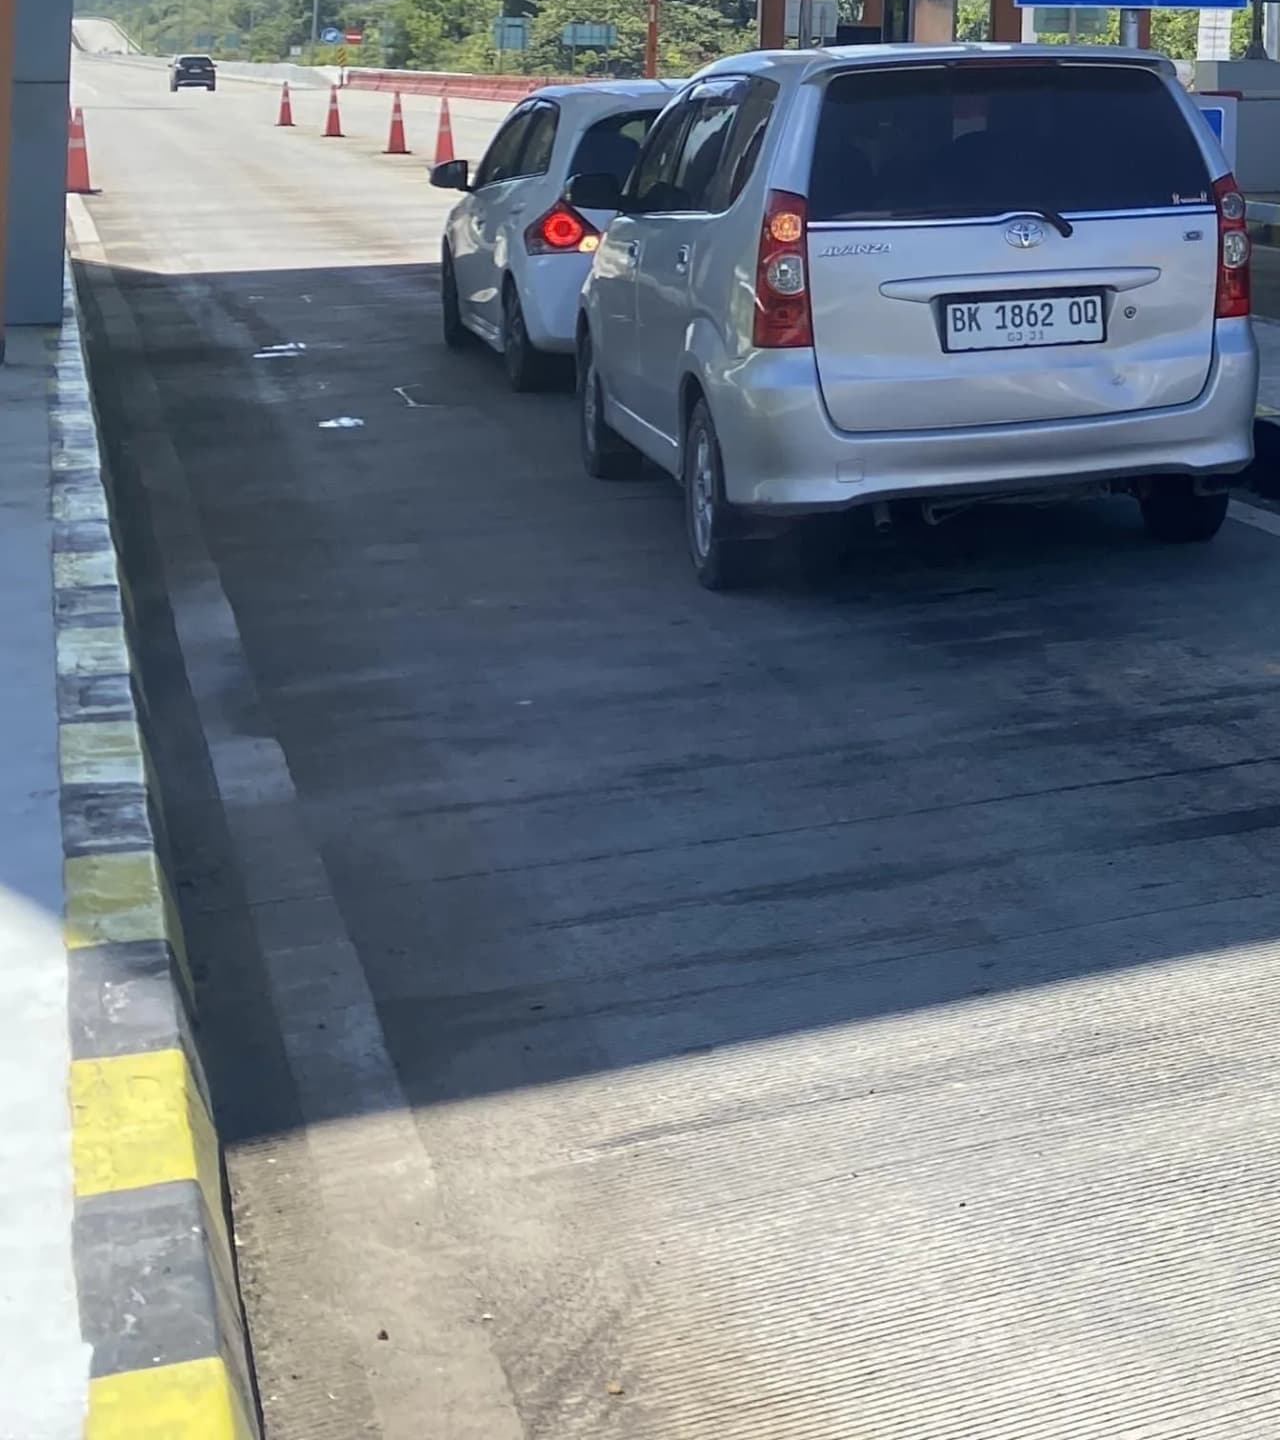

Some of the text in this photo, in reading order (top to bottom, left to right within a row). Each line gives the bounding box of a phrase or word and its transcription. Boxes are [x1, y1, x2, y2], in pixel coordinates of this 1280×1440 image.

[818, 242, 892, 257] AVANZA
[952, 306, 981, 332] BK
[995, 303, 1054, 329] 1862
